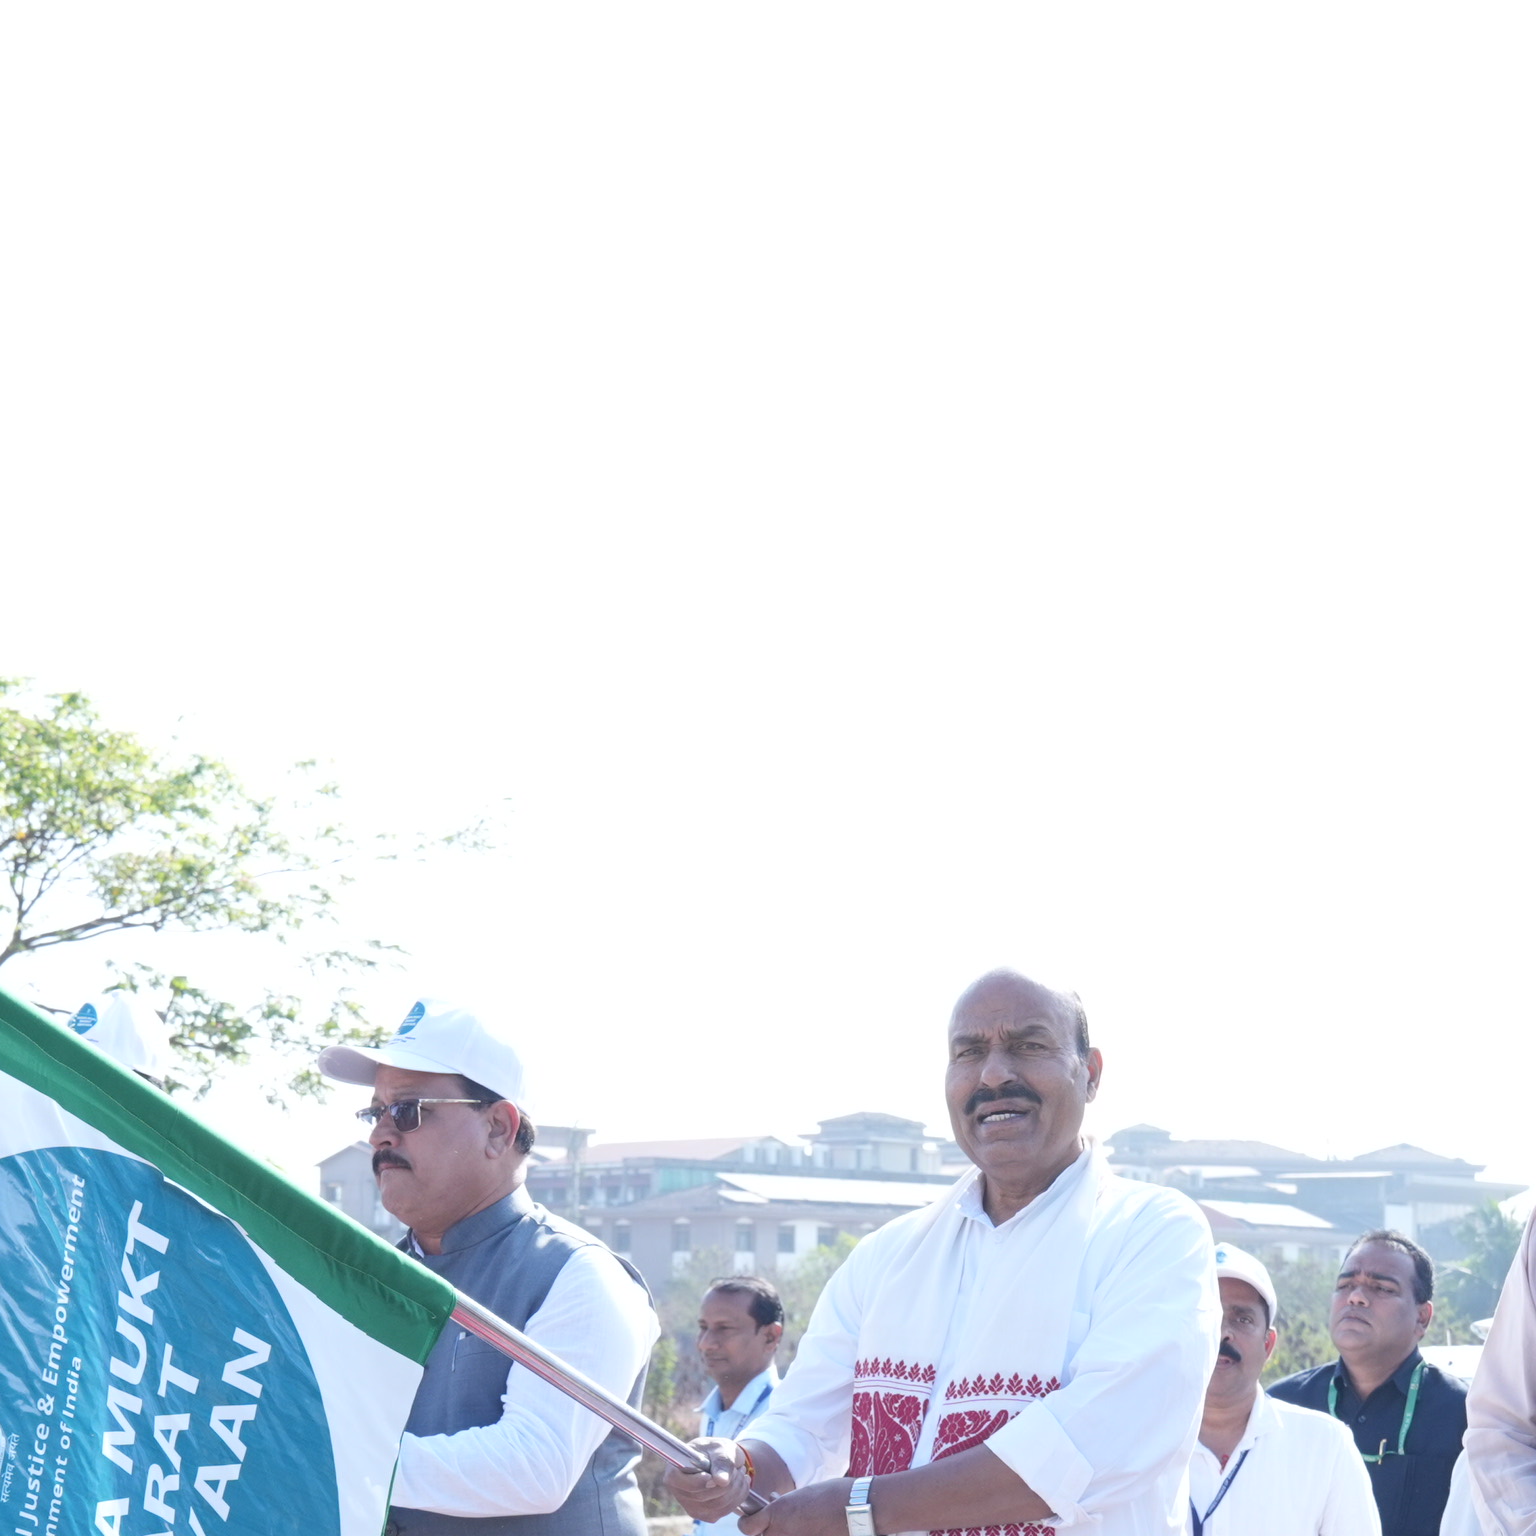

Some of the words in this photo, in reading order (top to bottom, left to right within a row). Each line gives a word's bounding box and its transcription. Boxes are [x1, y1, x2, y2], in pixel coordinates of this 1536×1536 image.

[42, 1174, 86, 1386] Empowerment
[102, 1199, 169, 1475] MUKT
[37, 1393, 55, 1416] &
[62, 1356, 82, 1418] India
[19, 1423, 50, 1527] Justice
[59, 1420, 74, 1450] of
